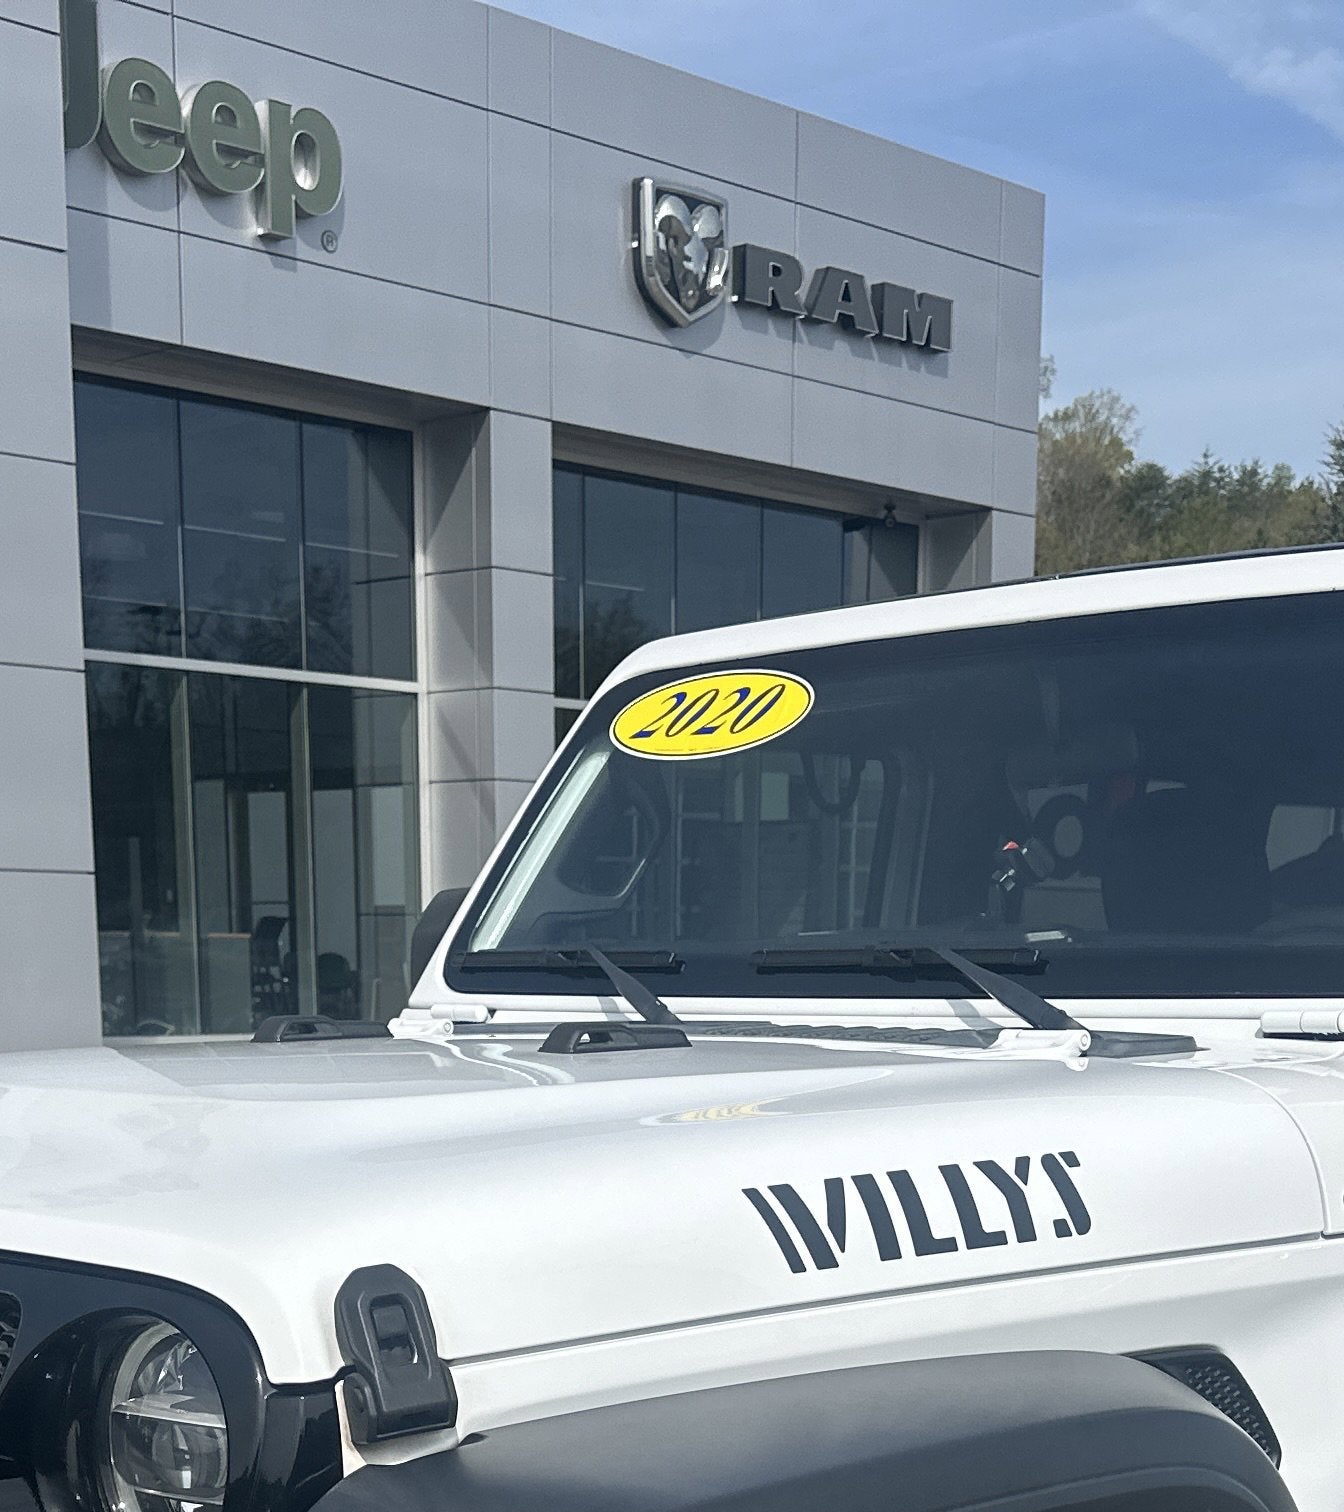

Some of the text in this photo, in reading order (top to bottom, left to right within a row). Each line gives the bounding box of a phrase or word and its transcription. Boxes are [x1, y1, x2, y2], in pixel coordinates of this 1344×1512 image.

[732, 243, 953, 351] RAM
[629, 684, 786, 739] 2020
[741, 1150, 1091, 1274] WILLYS
